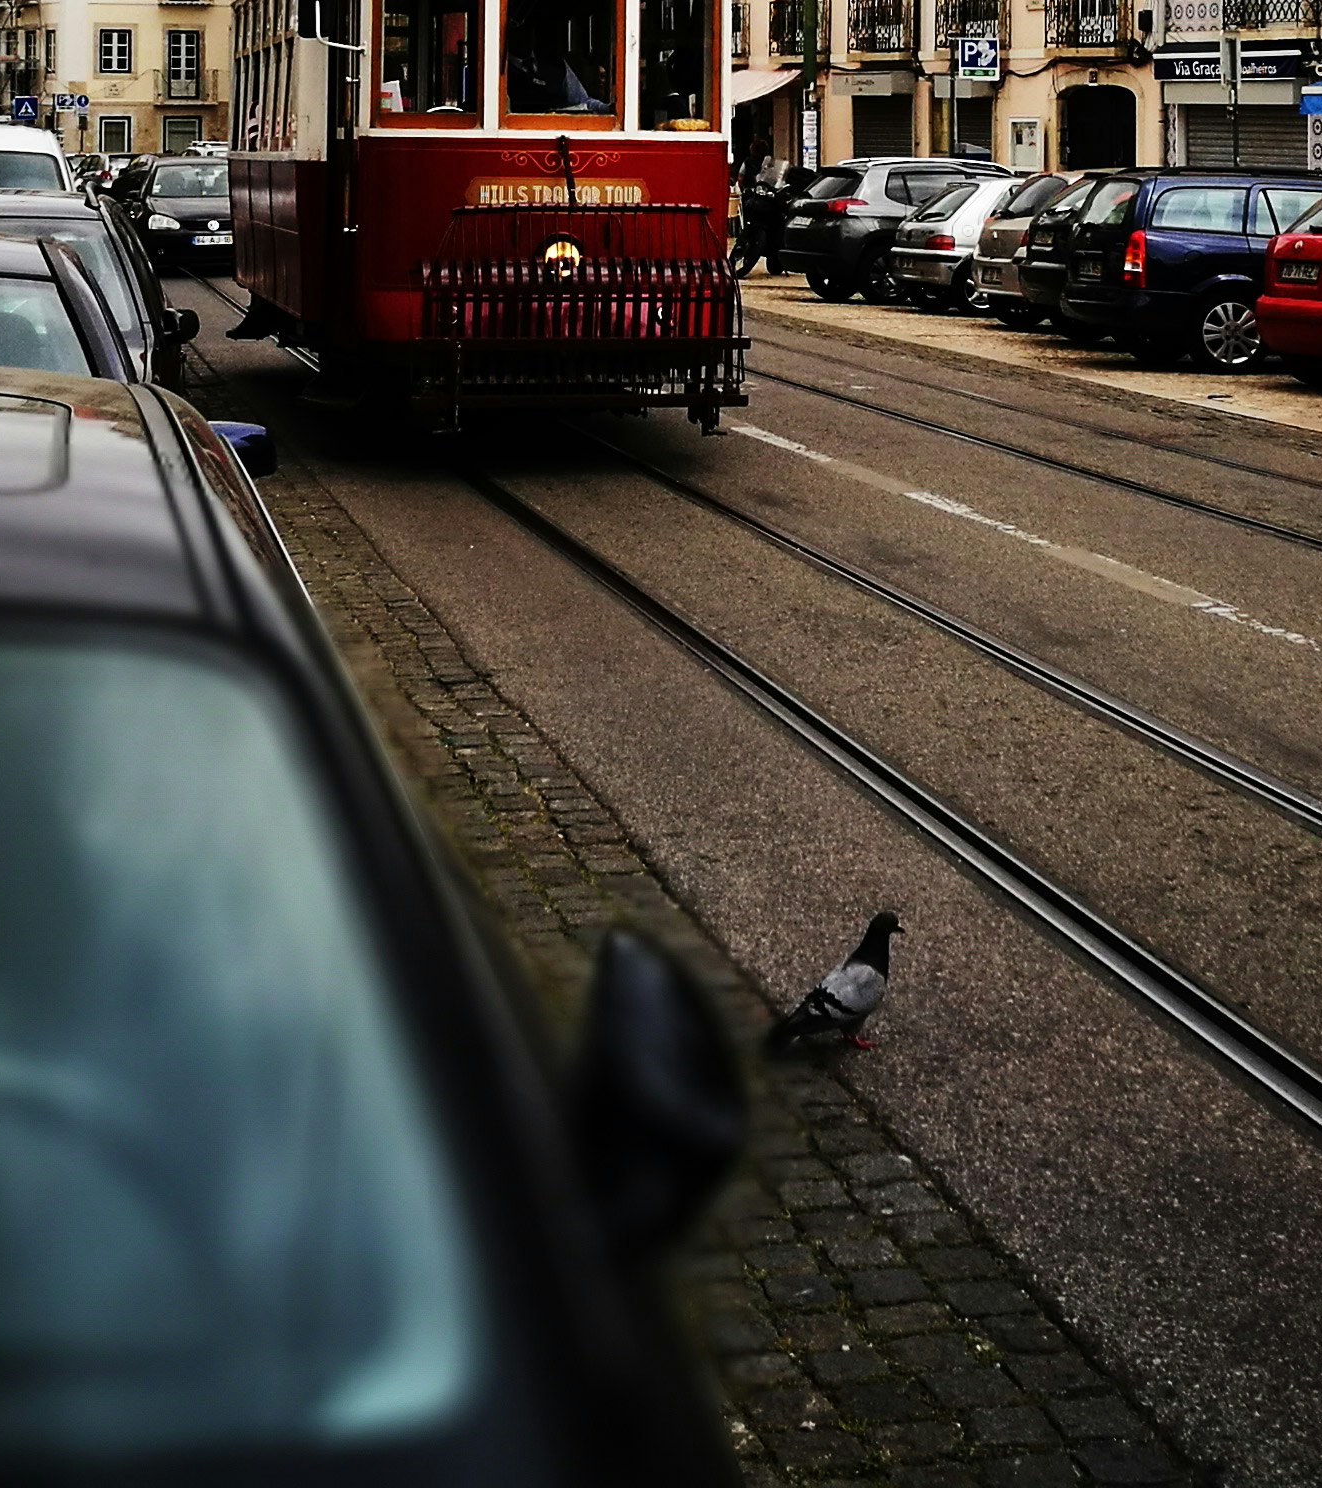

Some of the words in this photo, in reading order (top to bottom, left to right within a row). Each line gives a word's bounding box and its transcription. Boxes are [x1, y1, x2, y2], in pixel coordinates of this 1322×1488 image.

[964, 41, 978, 62] P
[1173, 61, 1191, 76] Via
[1241, 62, 1277, 74] oalheiros
[480, 184, 528, 204] HILLS
[604, 185, 642, 204] TOUR
